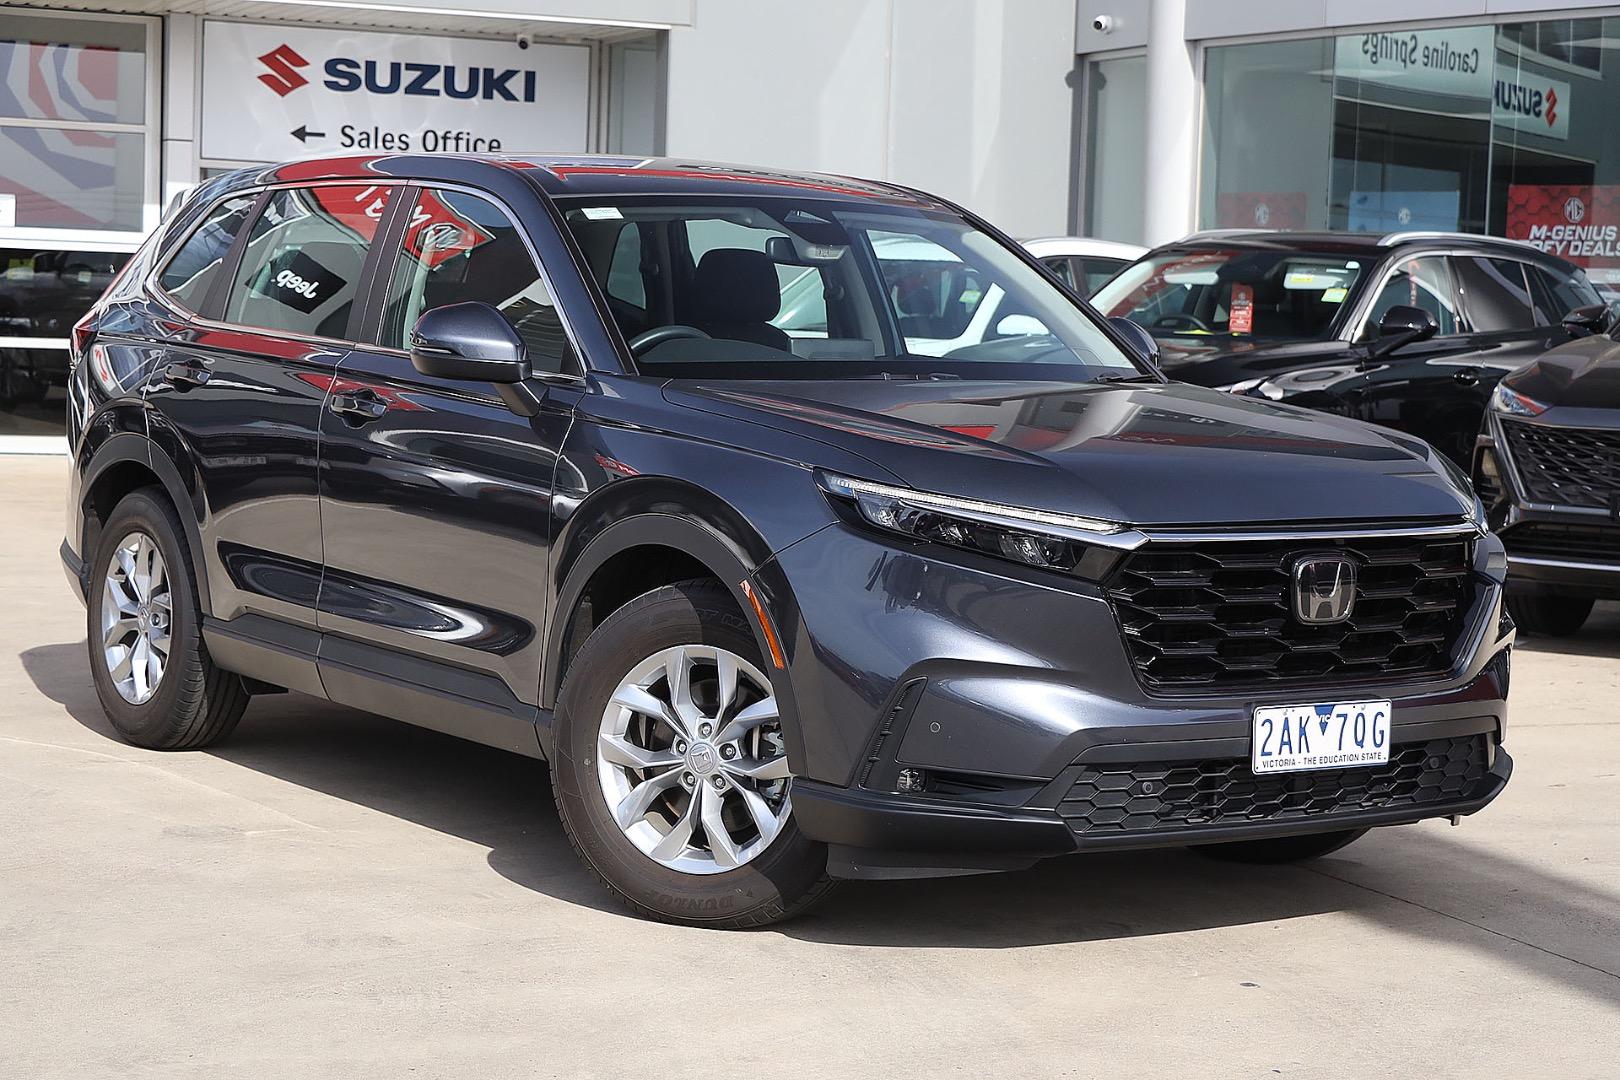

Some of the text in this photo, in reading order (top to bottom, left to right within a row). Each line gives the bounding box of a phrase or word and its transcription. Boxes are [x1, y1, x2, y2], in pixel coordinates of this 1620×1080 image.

[323, 57, 537, 103] SUZUKI
[340, 125, 502, 153] Sales Office
[1564, 197, 1584, 223] MG
[1528, 224, 1618, 241] M-GENIUS
[1260, 711, 1385, 757] 2AK 7QG
[1262, 758, 1296, 768] VICTORIA
[1303, 757, 1317, 765] THE
[1319, 754, 1359, 764] EDUCATION
[1360, 752, 1382, 761] STATE
